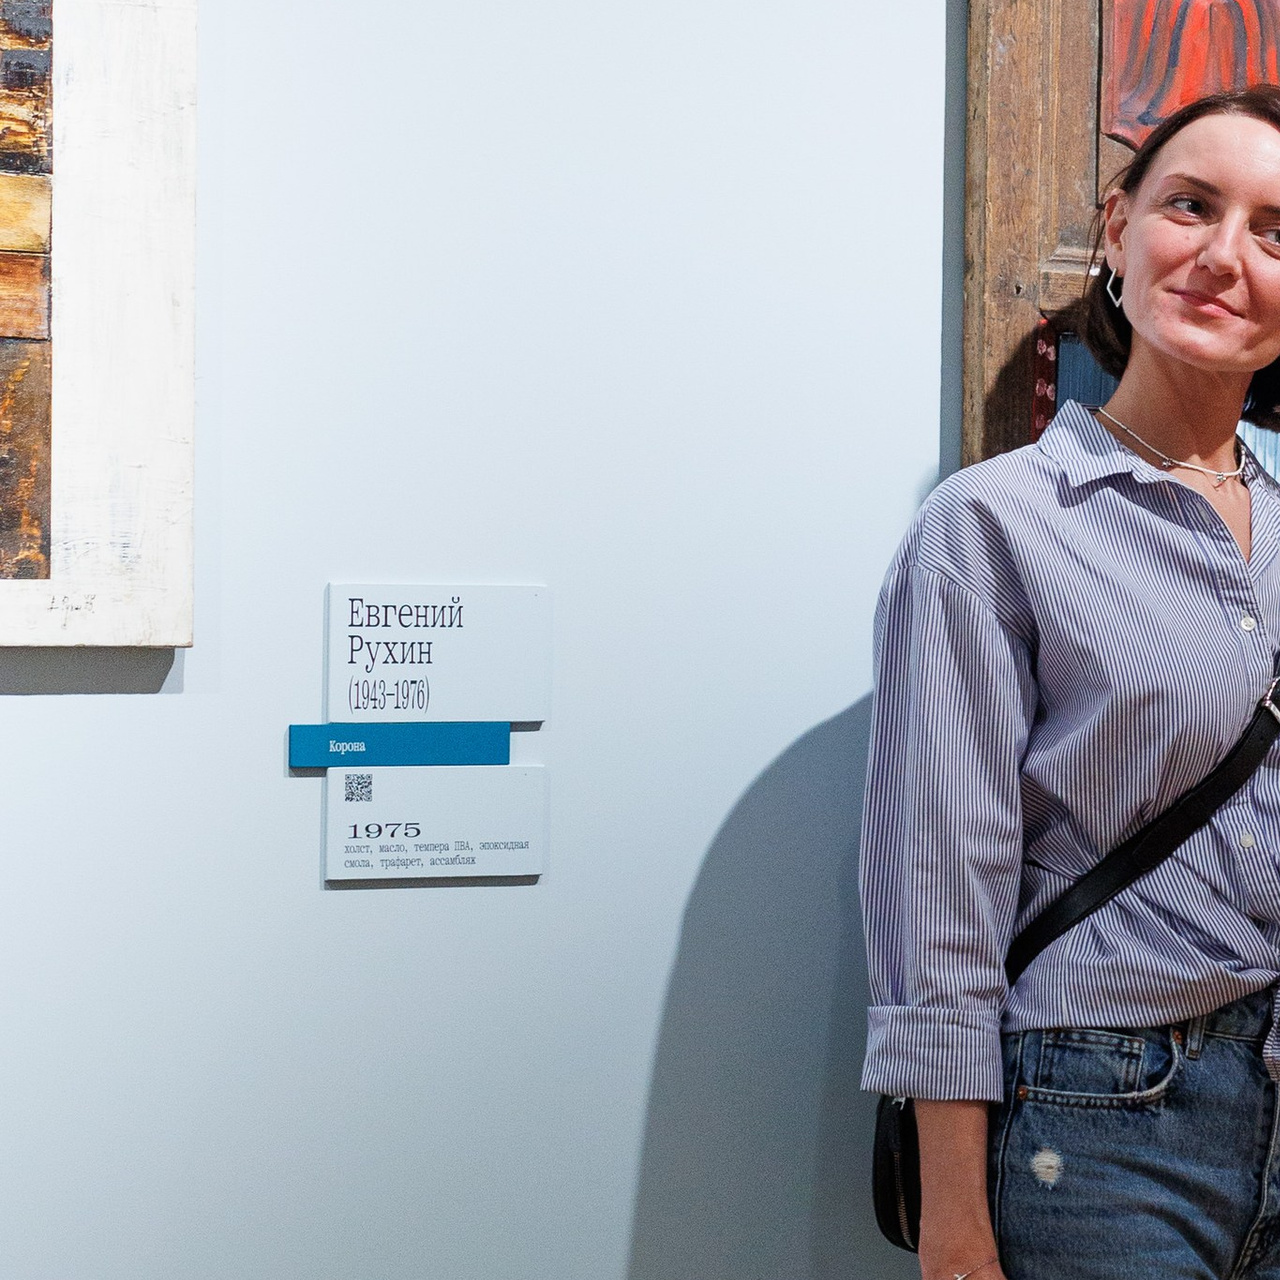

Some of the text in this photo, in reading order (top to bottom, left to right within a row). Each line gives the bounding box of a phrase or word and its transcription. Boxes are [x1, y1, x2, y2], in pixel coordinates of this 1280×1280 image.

[347, 595, 464, 629] Евгений
[347, 634, 434, 674] Рухин
[329, 739, 366, 755] Корона
[347, 822, 422, 840] 1975
[344, 840, 530, 855] холст, масло, темпера ПВА, эпоксидная
[344, 858, 374, 870] смола,
[379, 857, 424, 871] трафарет,
